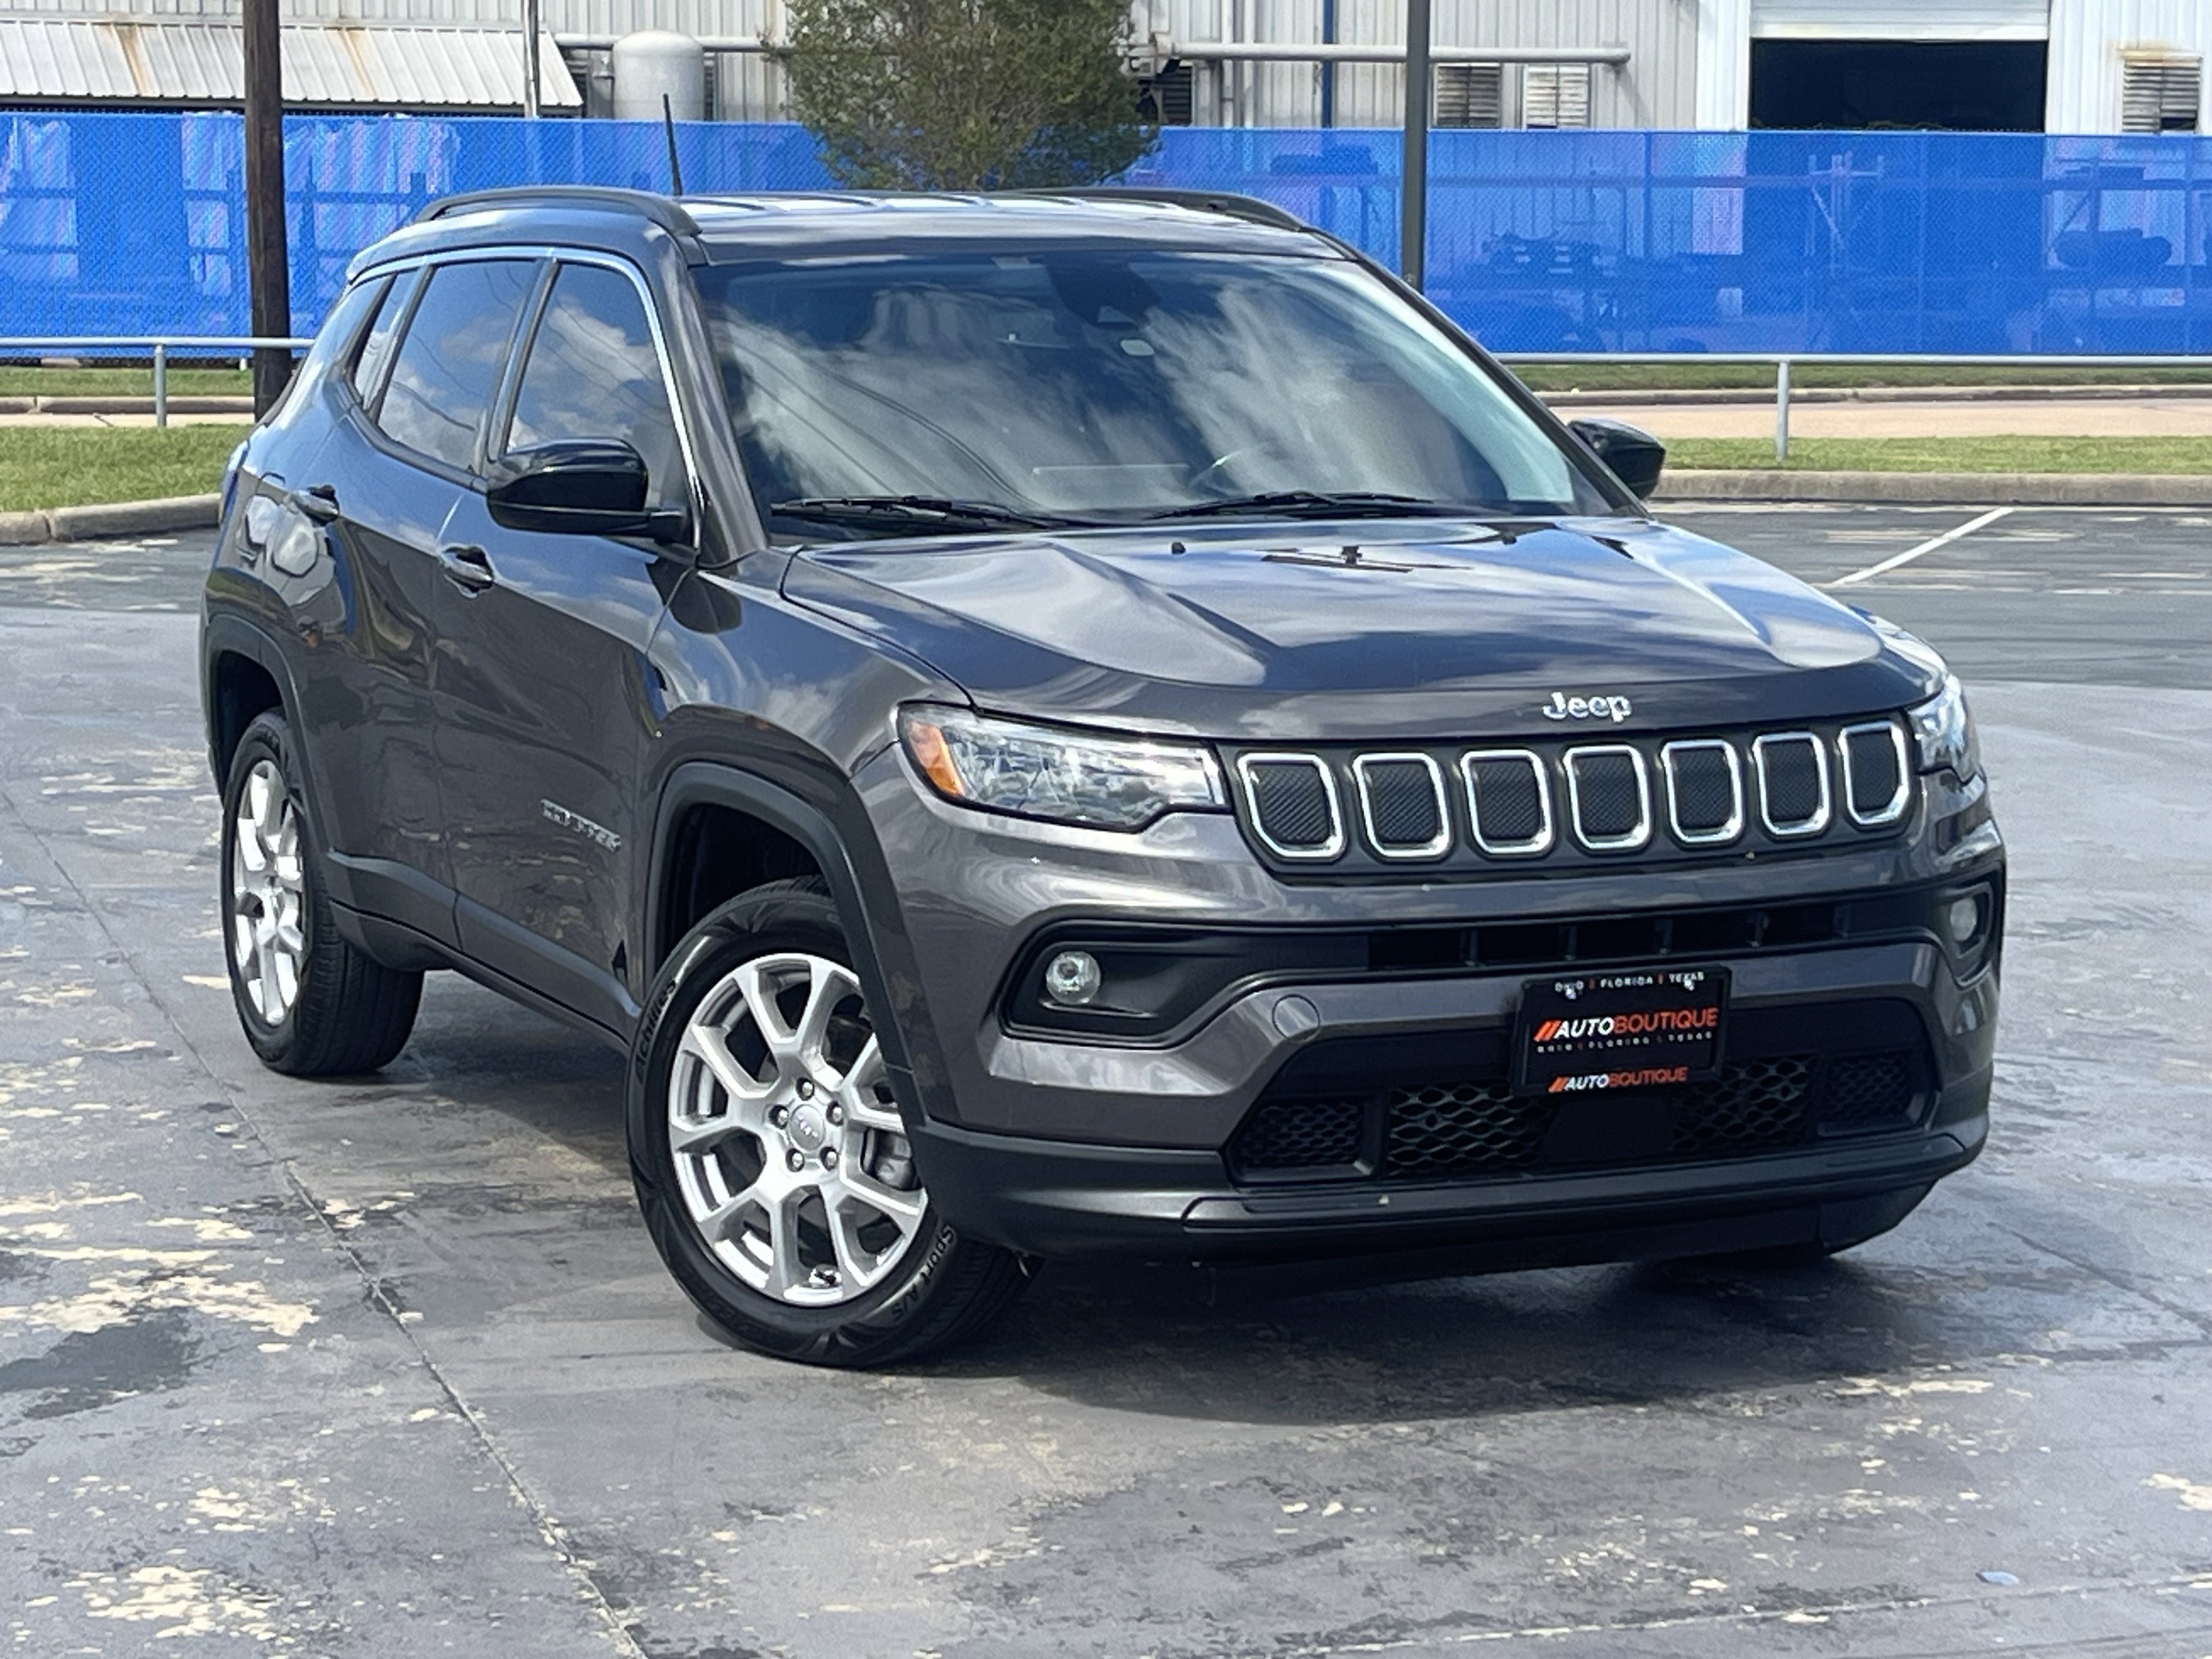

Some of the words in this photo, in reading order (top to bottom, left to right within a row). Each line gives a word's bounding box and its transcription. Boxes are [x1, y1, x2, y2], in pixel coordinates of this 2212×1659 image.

[1542, 691, 1632, 723] Jeep
[1600, 976, 1652, 988] FLORIDA
[1554, 1007, 1719, 1039] AUTOBOUTIQUE
[1564, 1066, 1688, 1091] AUTOBOUTIQUE
[920, 1224, 955, 1285] Sport
